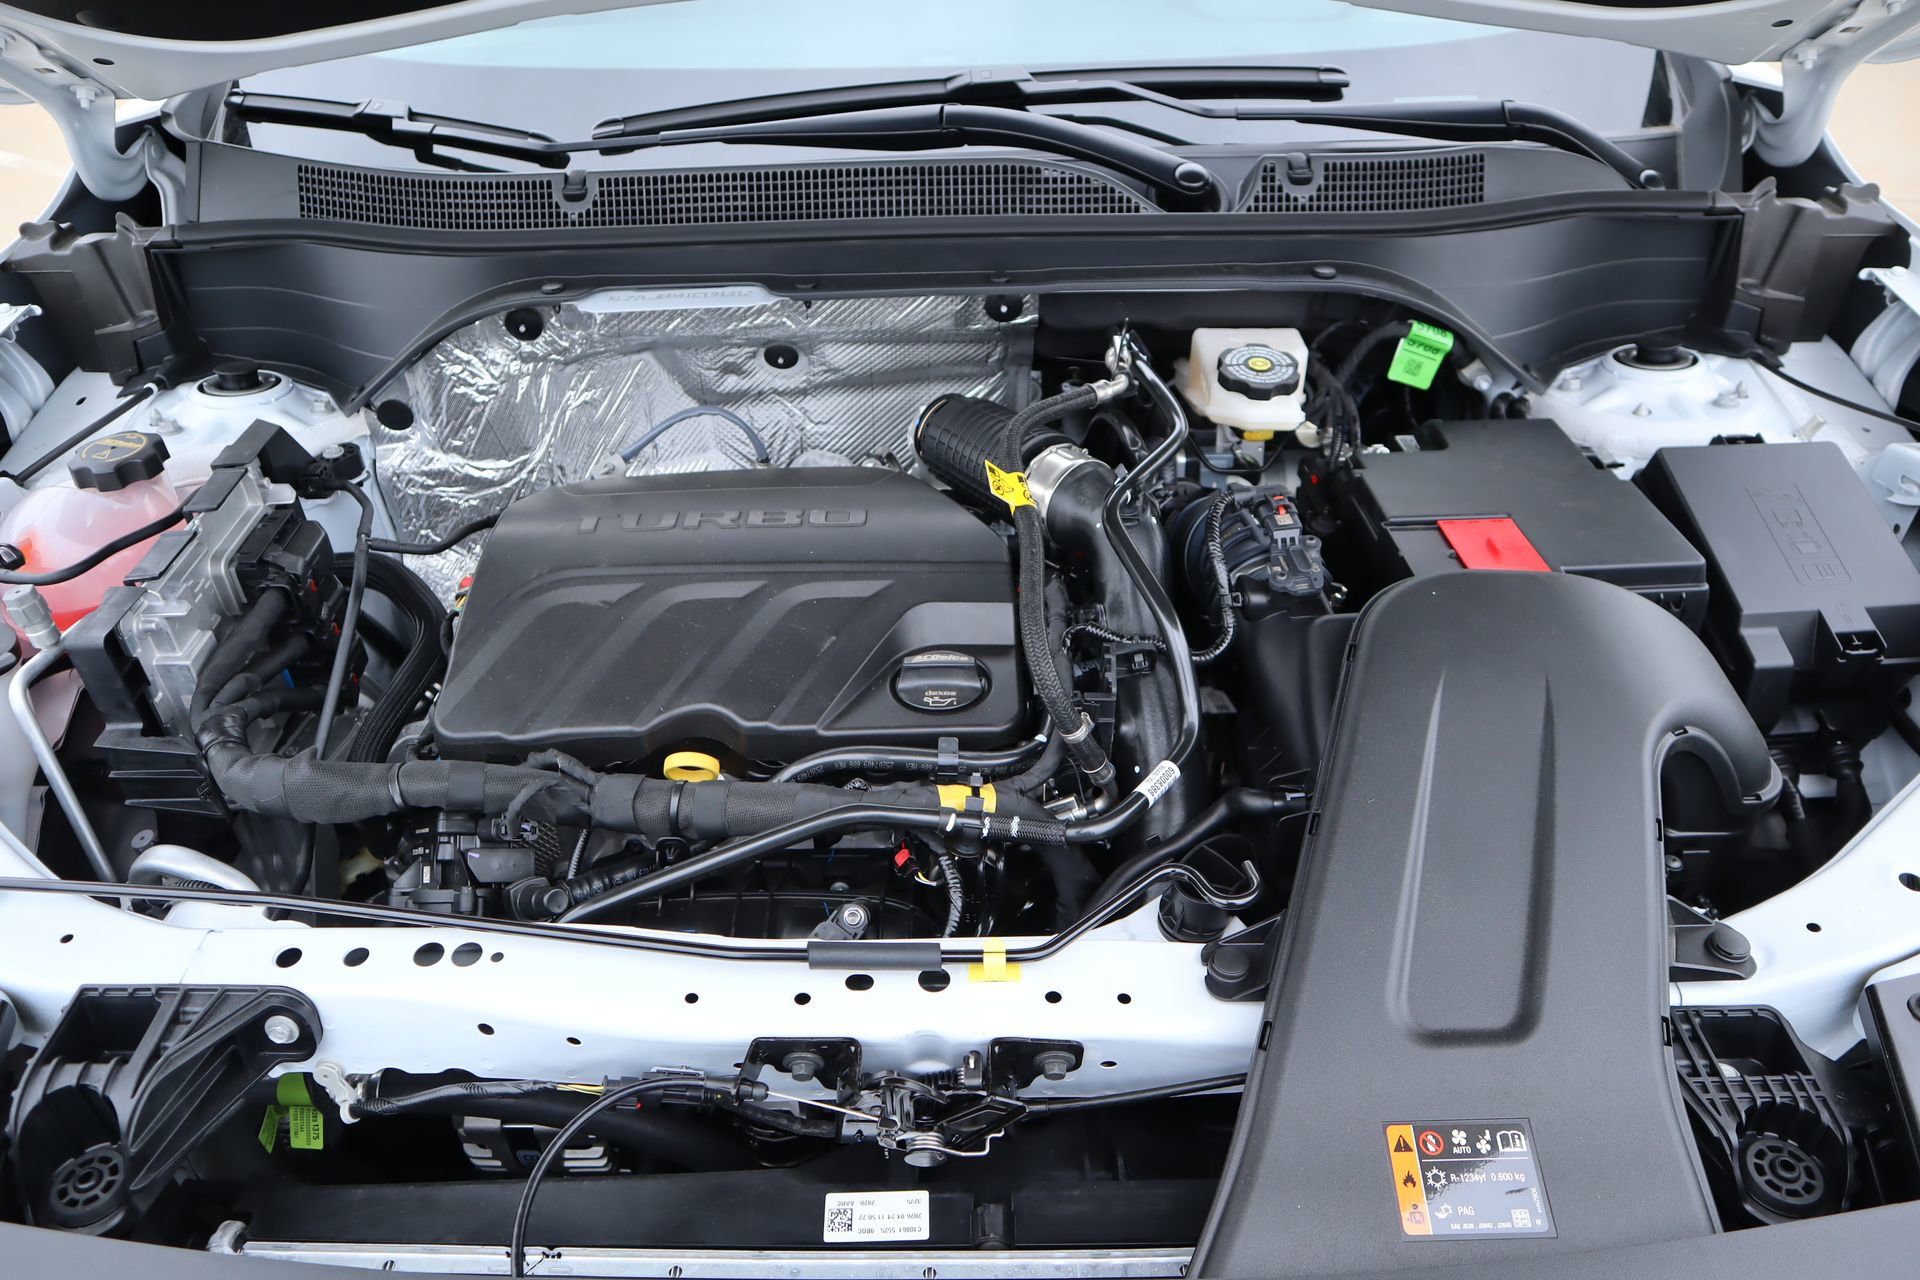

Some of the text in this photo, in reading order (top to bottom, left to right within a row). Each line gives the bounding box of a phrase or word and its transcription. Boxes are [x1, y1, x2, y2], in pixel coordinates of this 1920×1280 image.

[576, 508, 868, 534] TURBO
[911, 654, 969, 663] ACDelco
[312, 1124, 320, 1141] 1375
[1452, 1145, 1472, 1154] AUTO
[1450, 1171, 1526, 1184] R-1234yf 0.600 kg
[1457, 1205, 1475, 1216] PAG
